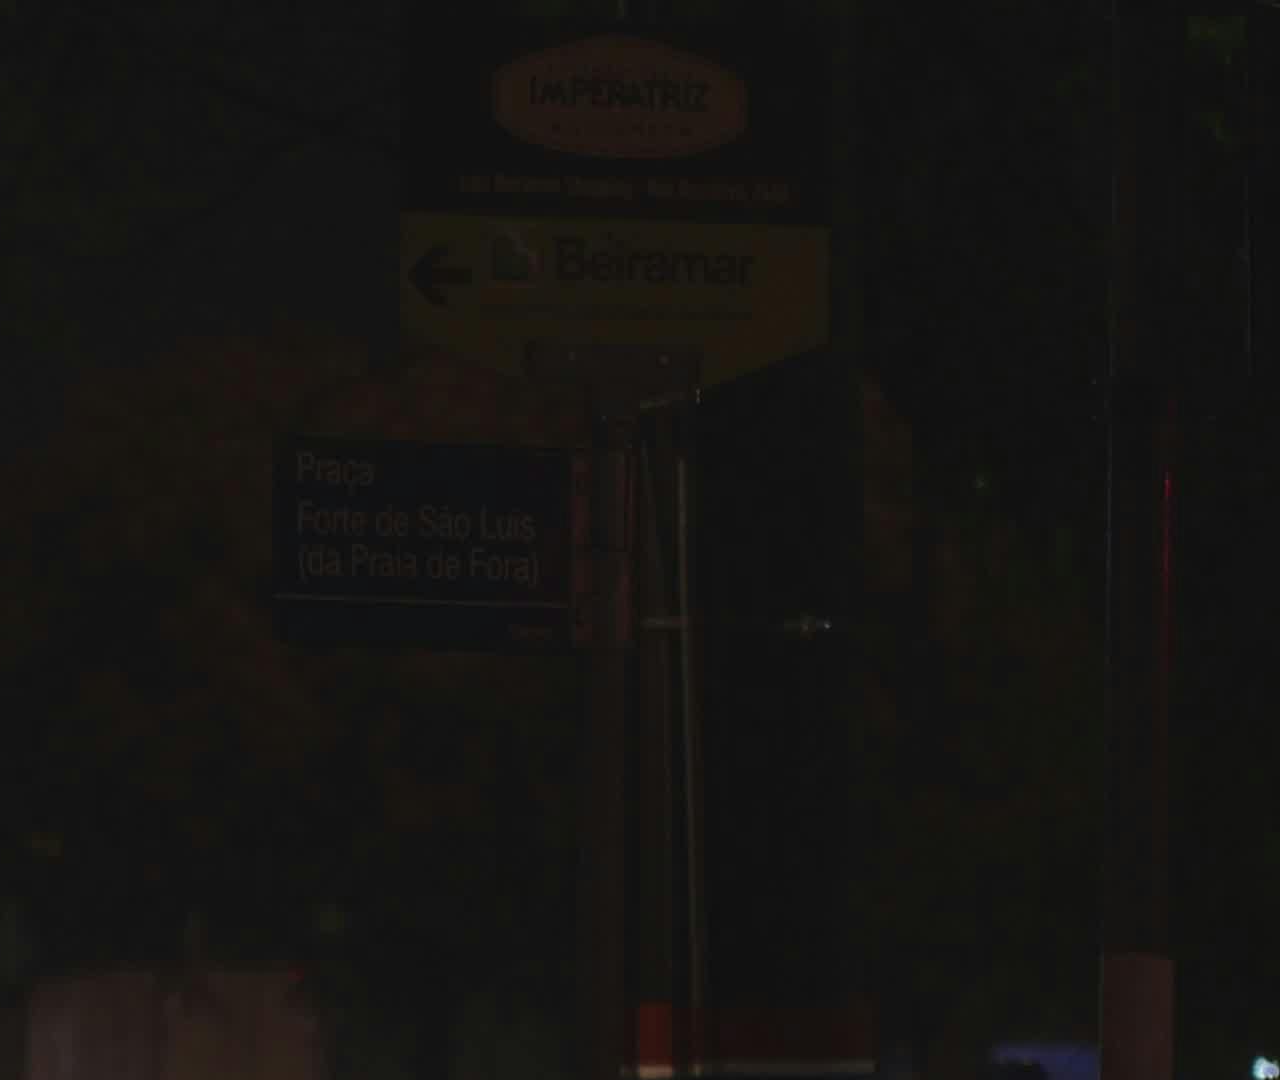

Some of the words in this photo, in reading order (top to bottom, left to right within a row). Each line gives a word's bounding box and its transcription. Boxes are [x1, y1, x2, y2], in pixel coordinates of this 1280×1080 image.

[528, 74, 711, 113] IMPERATRIZ
[553, 234, 755, 288] Beiramar
[295, 451, 375, 496] Praça
[295, 498, 367, 538] Forte
[375, 504, 409, 538] de
[416, 503, 473, 542] São
[296, 545, 344, 585] (da
[351, 544, 417, 580] Praia
[425, 547, 461, 583] de
[470, 546, 542, 589] Fora)
